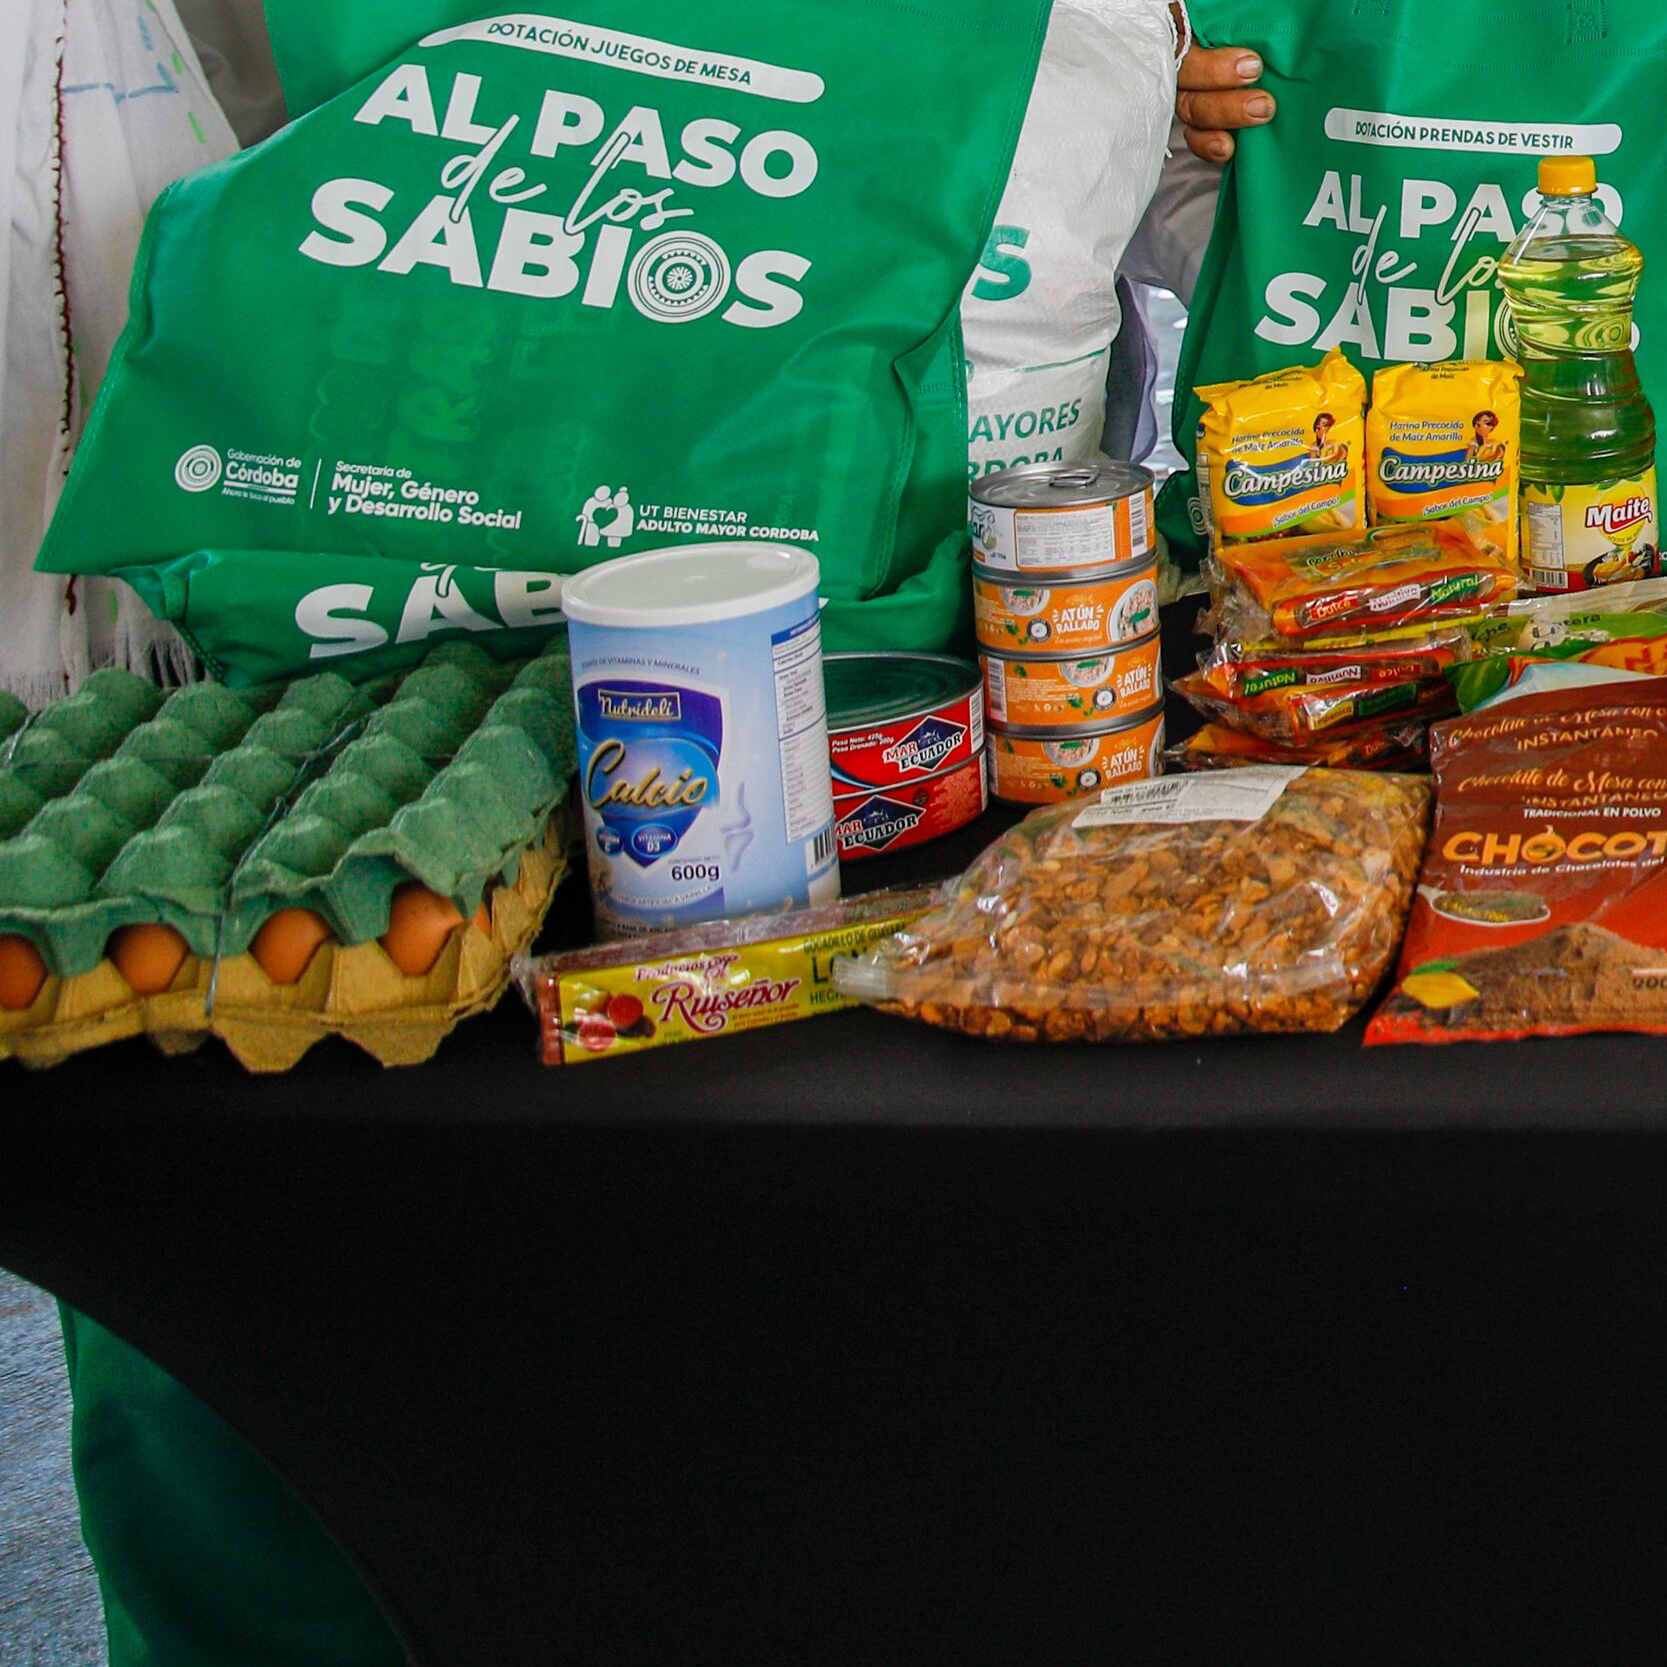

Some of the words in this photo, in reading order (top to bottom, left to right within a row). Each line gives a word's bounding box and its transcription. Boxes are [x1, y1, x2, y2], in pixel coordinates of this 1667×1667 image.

[487, 22, 589, 53] DOTACIÓN
[590, 38, 671, 70] JUEGOS
[673, 58, 699, 75] DE
[700, 64, 752, 85] MESA
[353, 63, 498, 146] AL
[530, 89, 818, 198] PASO
[1355, 121, 1415, 141] DOTACIÓN
[1420, 126, 1495, 146] PRENDAS
[1498, 133, 1518, 147] DE
[1520, 134, 1573, 149] VESTIR
[442, 114, 547, 224] de
[1302, 171, 1374, 235] AL
[298, 177, 812, 328] SABIOS
[1353, 205, 1417, 304] de
[1390, 421, 1420, 431] Harina
[1422, 420, 1464, 430] Precocida
[1390, 433, 1401, 442] de
[1426, 431, 1463, 442] Amarillo
[225, 462, 299, 488] Córdoba
[286, 457, 302, 469] de
[397, 467, 412, 479] de
[1380, 456, 1502, 485] Campesina
[332, 474, 395, 500] Mujer,
[400, 480, 479, 505] Género
[1225, 460, 1347, 496] Campesina
[328, 498, 341, 515] y
[345, 496, 453, 522] Desarrollo
[458, 506, 522, 529] Social
[640, 505, 660, 517] UT
[663, 505, 747, 523] BIENESTAR
[1299, 505, 1310, 515] del
[1450, 500, 1460, 511] del
[1586, 497, 1651, 533] Maite
[637, 519, 693, 535] ADULTO
[696, 523, 746, 538] MAYOR
[750, 527, 819, 541] CORDOBA
[1432, 575, 1479, 600] Natural
[1056, 619, 1100, 634] RALLADO
[1061, 605, 1094, 623] ATÚN
[1124, 665, 1148, 687] ATÚN
[885, 741, 917, 761] MAR
[900, 732, 961, 770] ECUADOR
[1110, 747, 1137, 768] ATÚN
[586, 738, 707, 810] Calcio
[1603, 808, 1619, 818] EN
[1623, 807, 1661, 818] POLVO
[844, 815, 917, 848] ECUADOR
[647, 841, 660, 853] D3
[671, 864, 720, 881] 600g
[1460, 863, 1527, 878] Industria
[1531, 865, 1550, 876] de
[1554, 858, 1638, 874] Chocolates
[1641, 853, 1664, 868] del
[651, 978, 801, 1034] Ruiseñor
